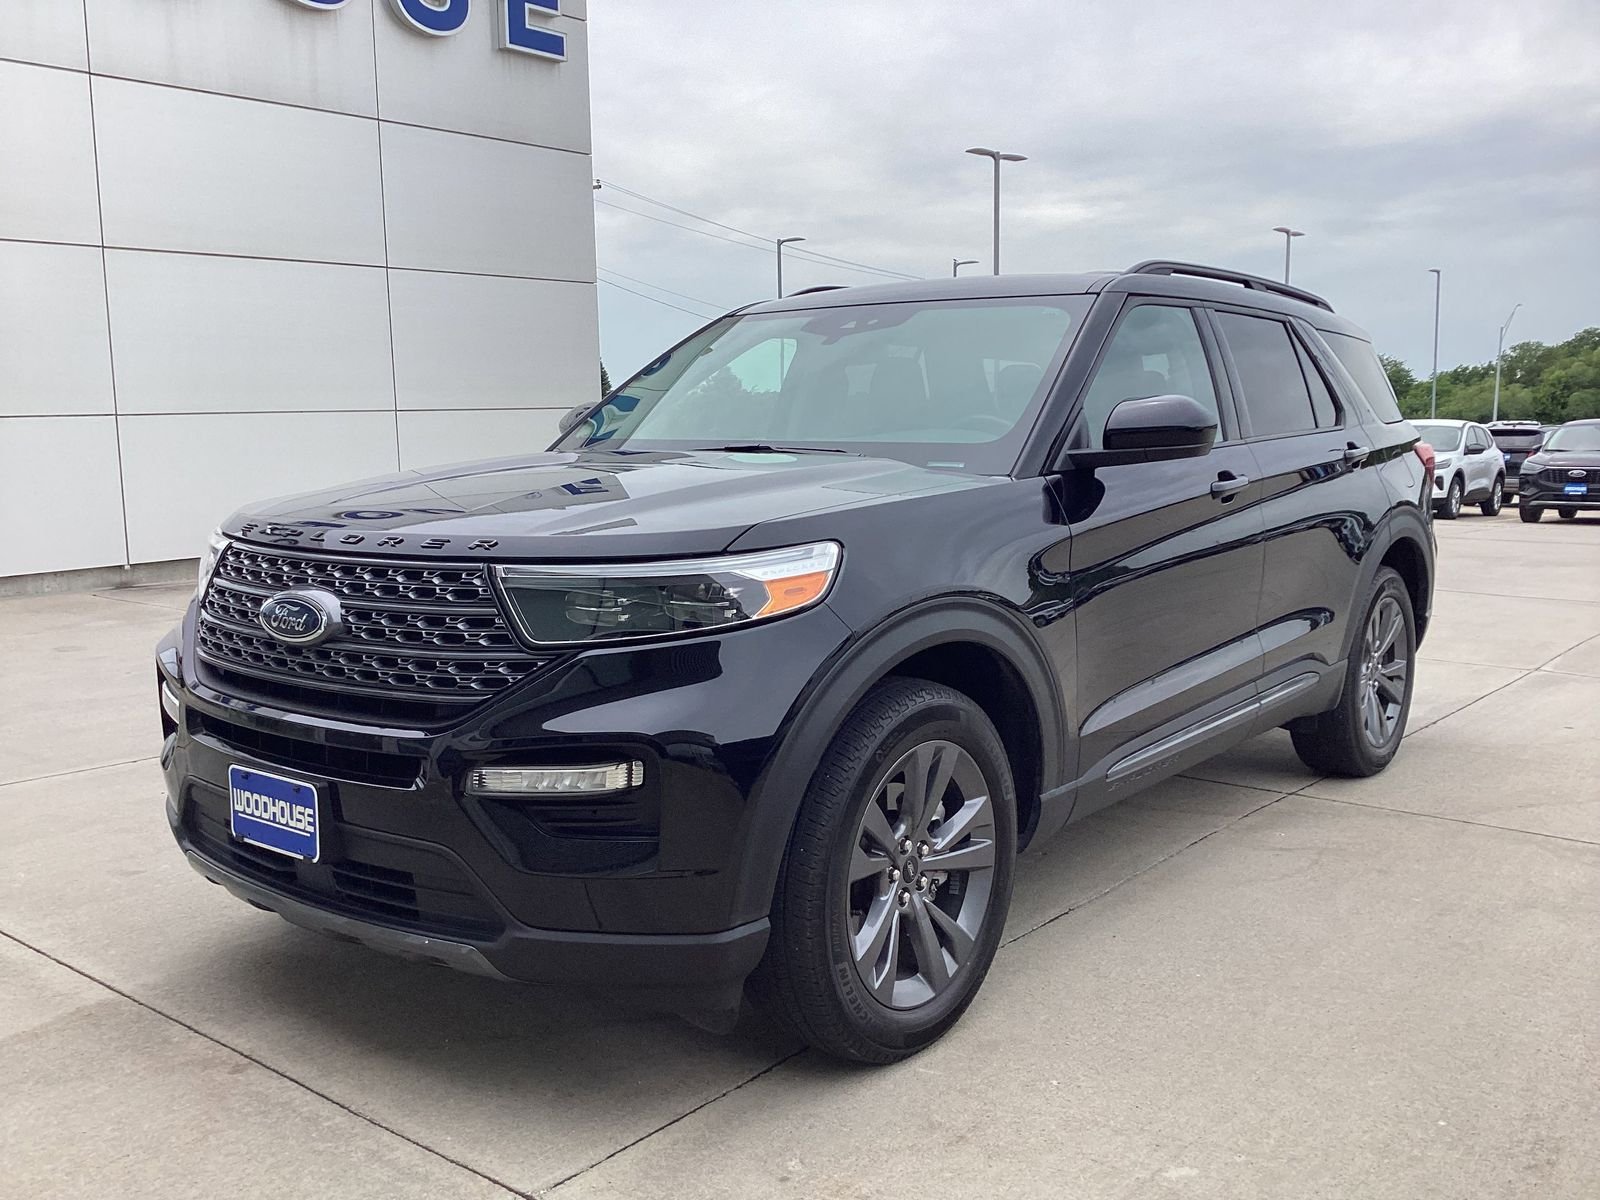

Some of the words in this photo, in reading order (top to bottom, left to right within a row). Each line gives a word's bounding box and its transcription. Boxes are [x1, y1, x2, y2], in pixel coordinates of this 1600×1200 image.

[271, 603, 309, 631] Ford
[233, 787, 315, 832] WOODHOUSE
[838, 966, 877, 1027] ICHELIN
